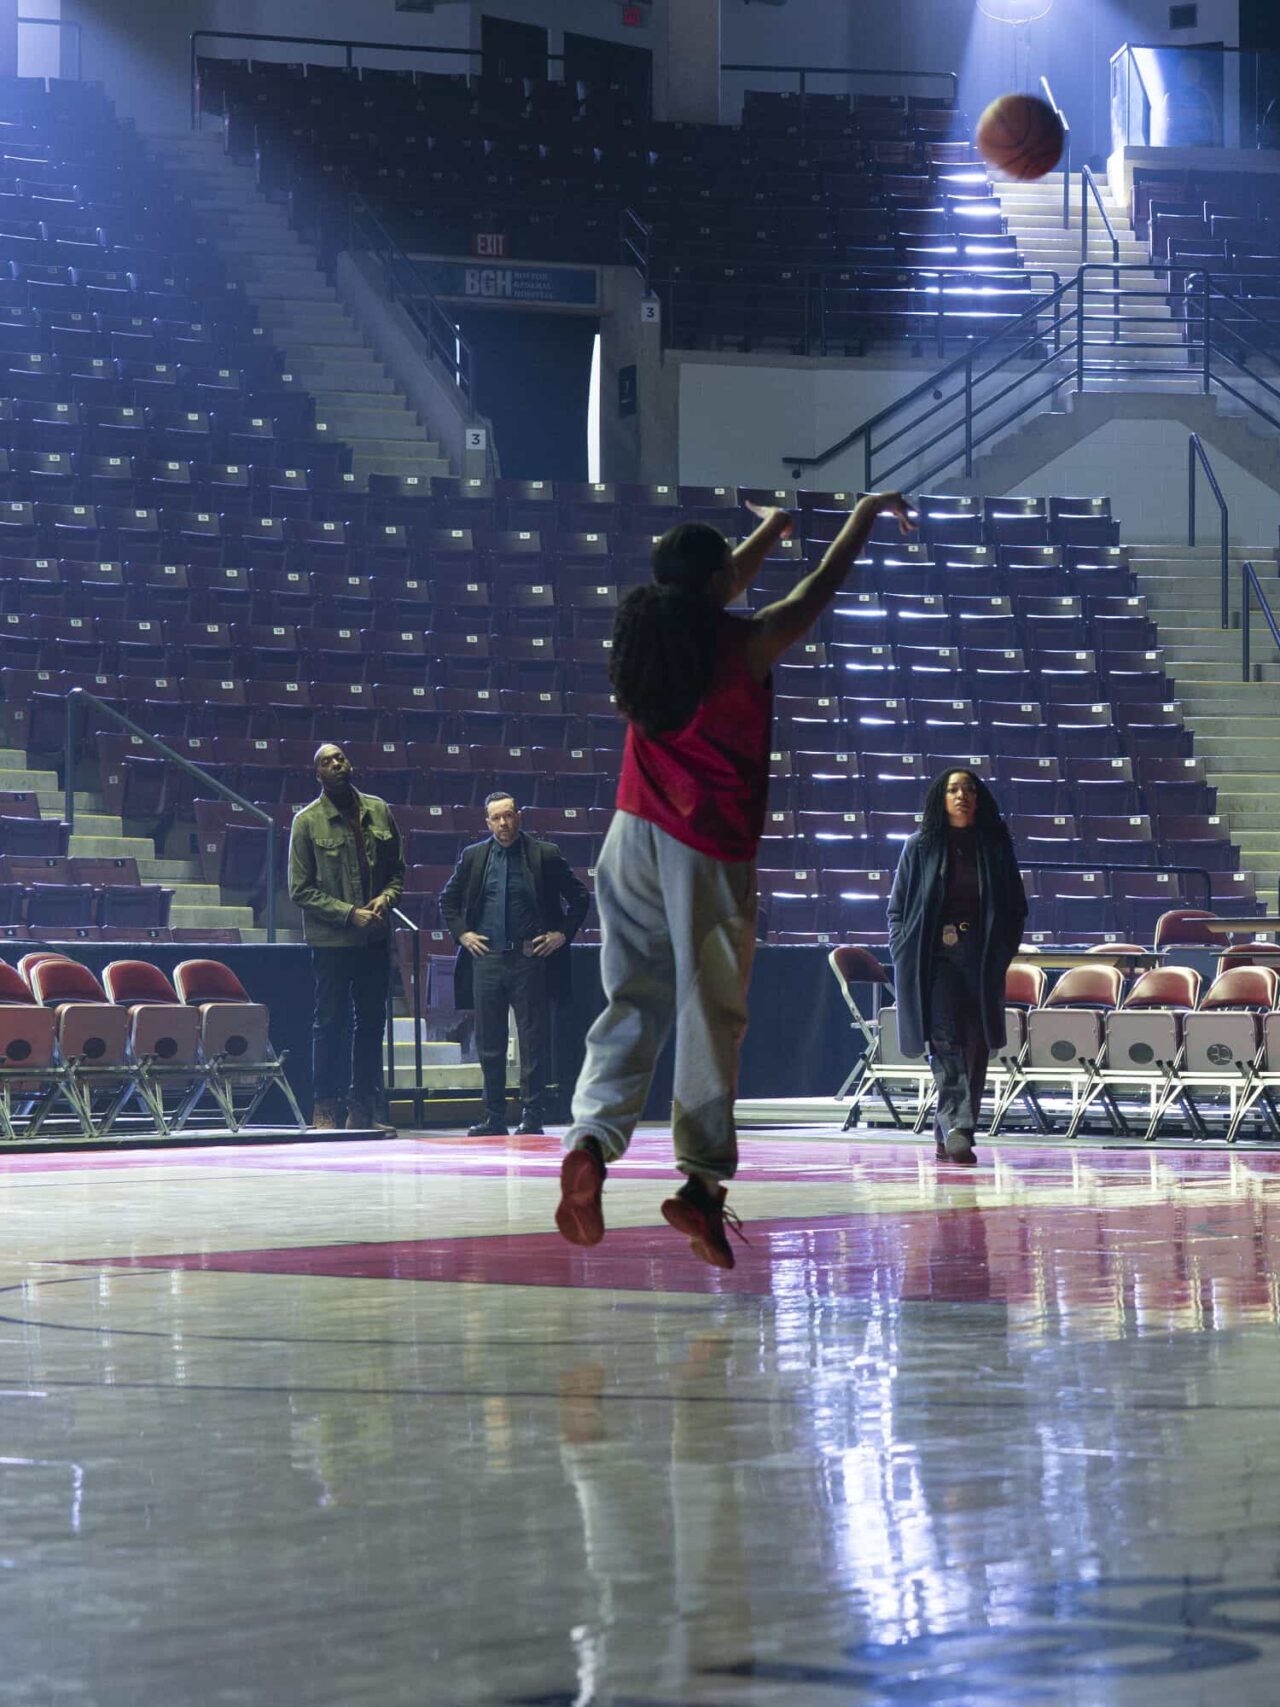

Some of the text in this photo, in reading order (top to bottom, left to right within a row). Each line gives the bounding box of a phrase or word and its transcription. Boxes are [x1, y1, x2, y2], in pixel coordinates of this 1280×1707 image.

[478, 234, 504, 256] EXIT
[465, 269, 512, 297] BGH
[646, 308, 654, 318] 3
[472, 434, 480, 445] 3
